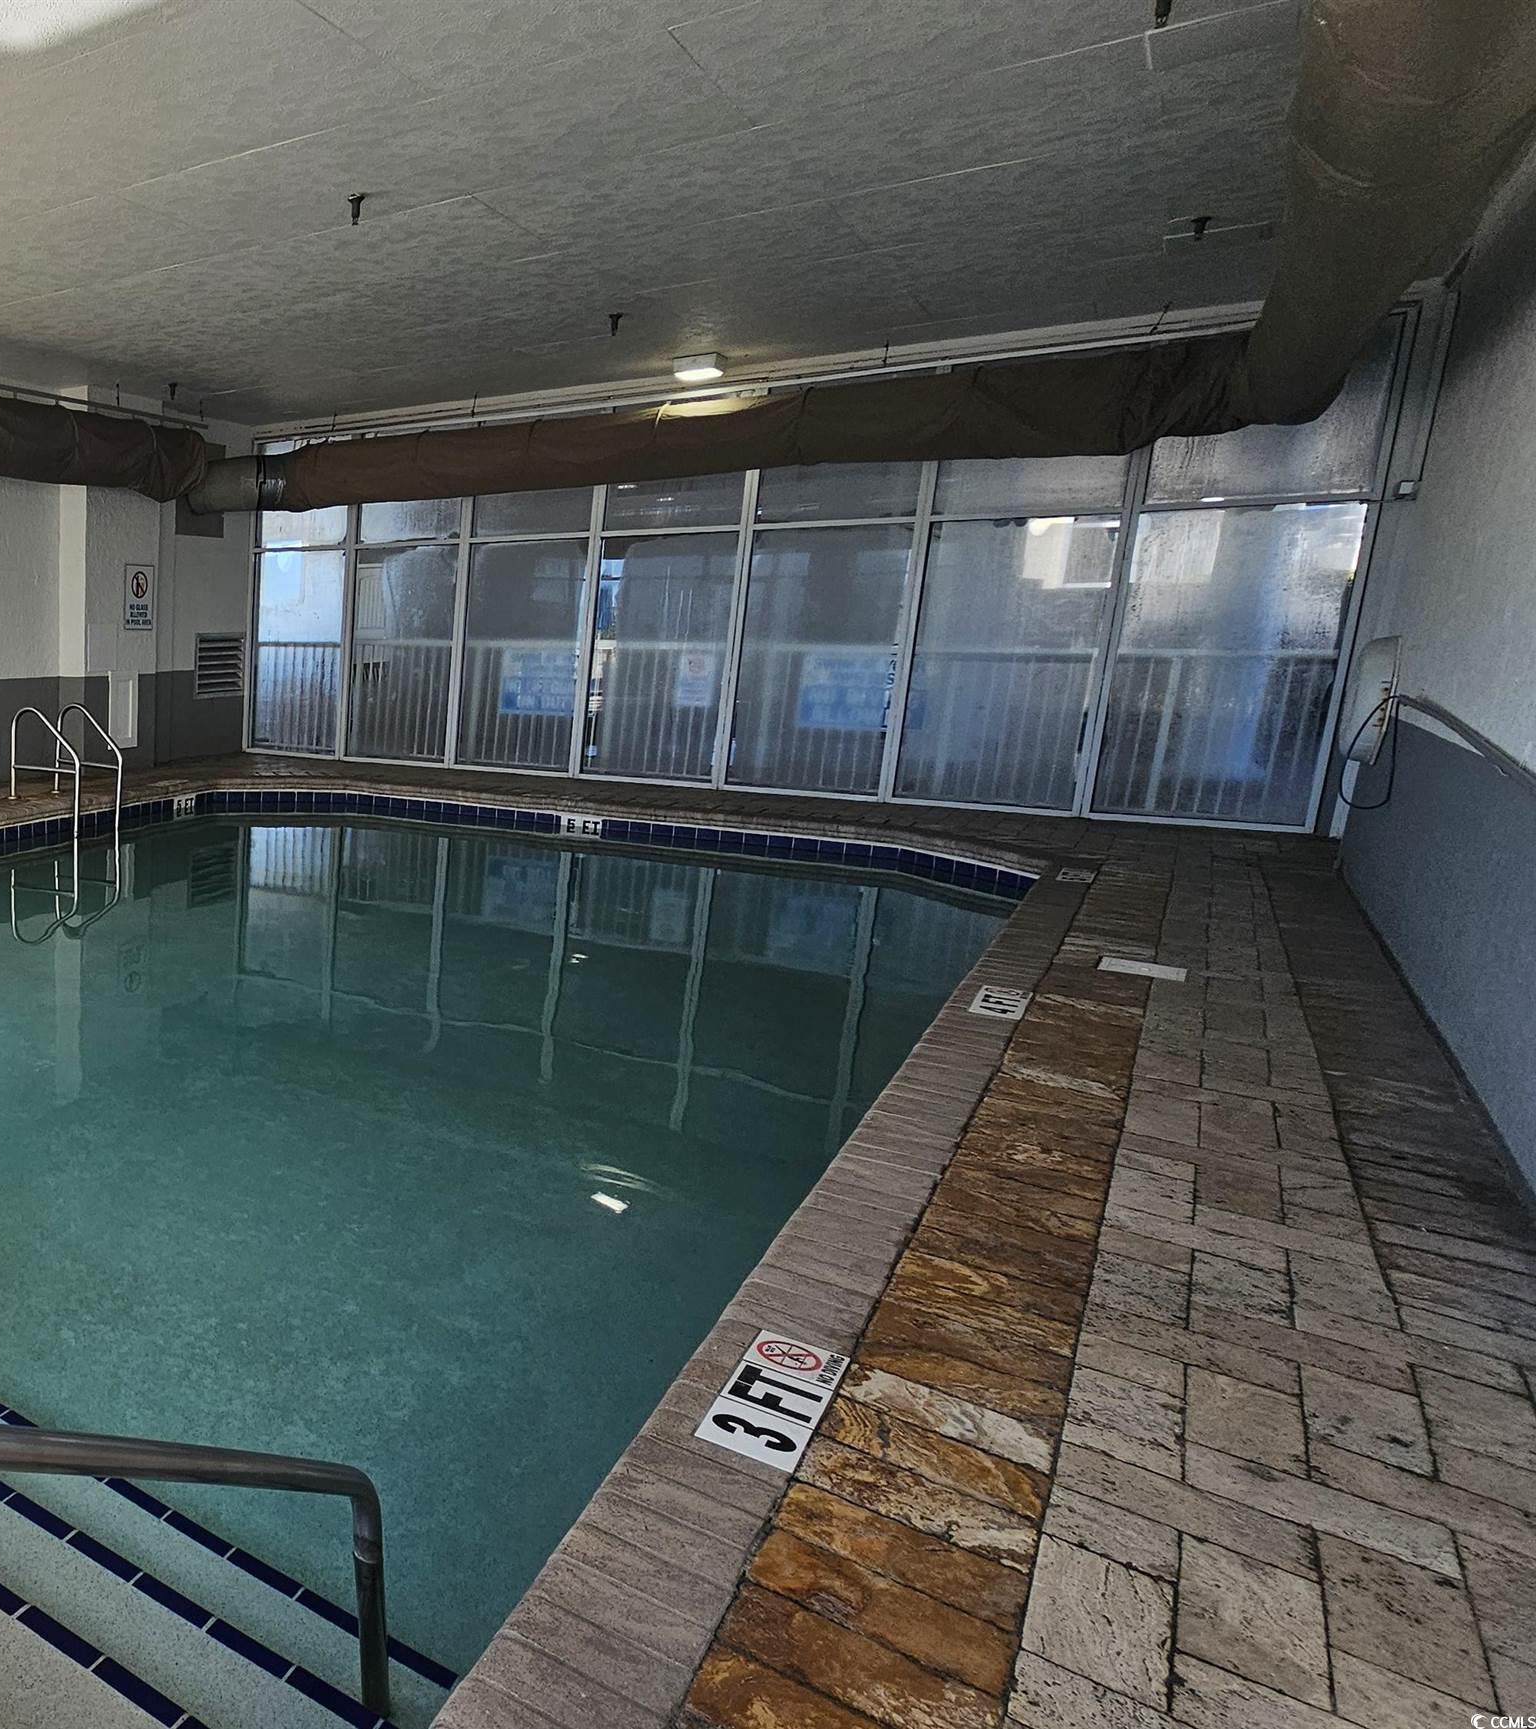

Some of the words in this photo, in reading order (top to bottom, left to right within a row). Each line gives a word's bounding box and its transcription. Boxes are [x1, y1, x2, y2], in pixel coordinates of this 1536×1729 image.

[981, 994, 1021, 1007] FT
[821, 1354, 846, 1376] DIVING
[816, 1373, 834, 1386] NO
[727, 1364, 823, 1423] FT
[712, 1413, 797, 1452] 3
